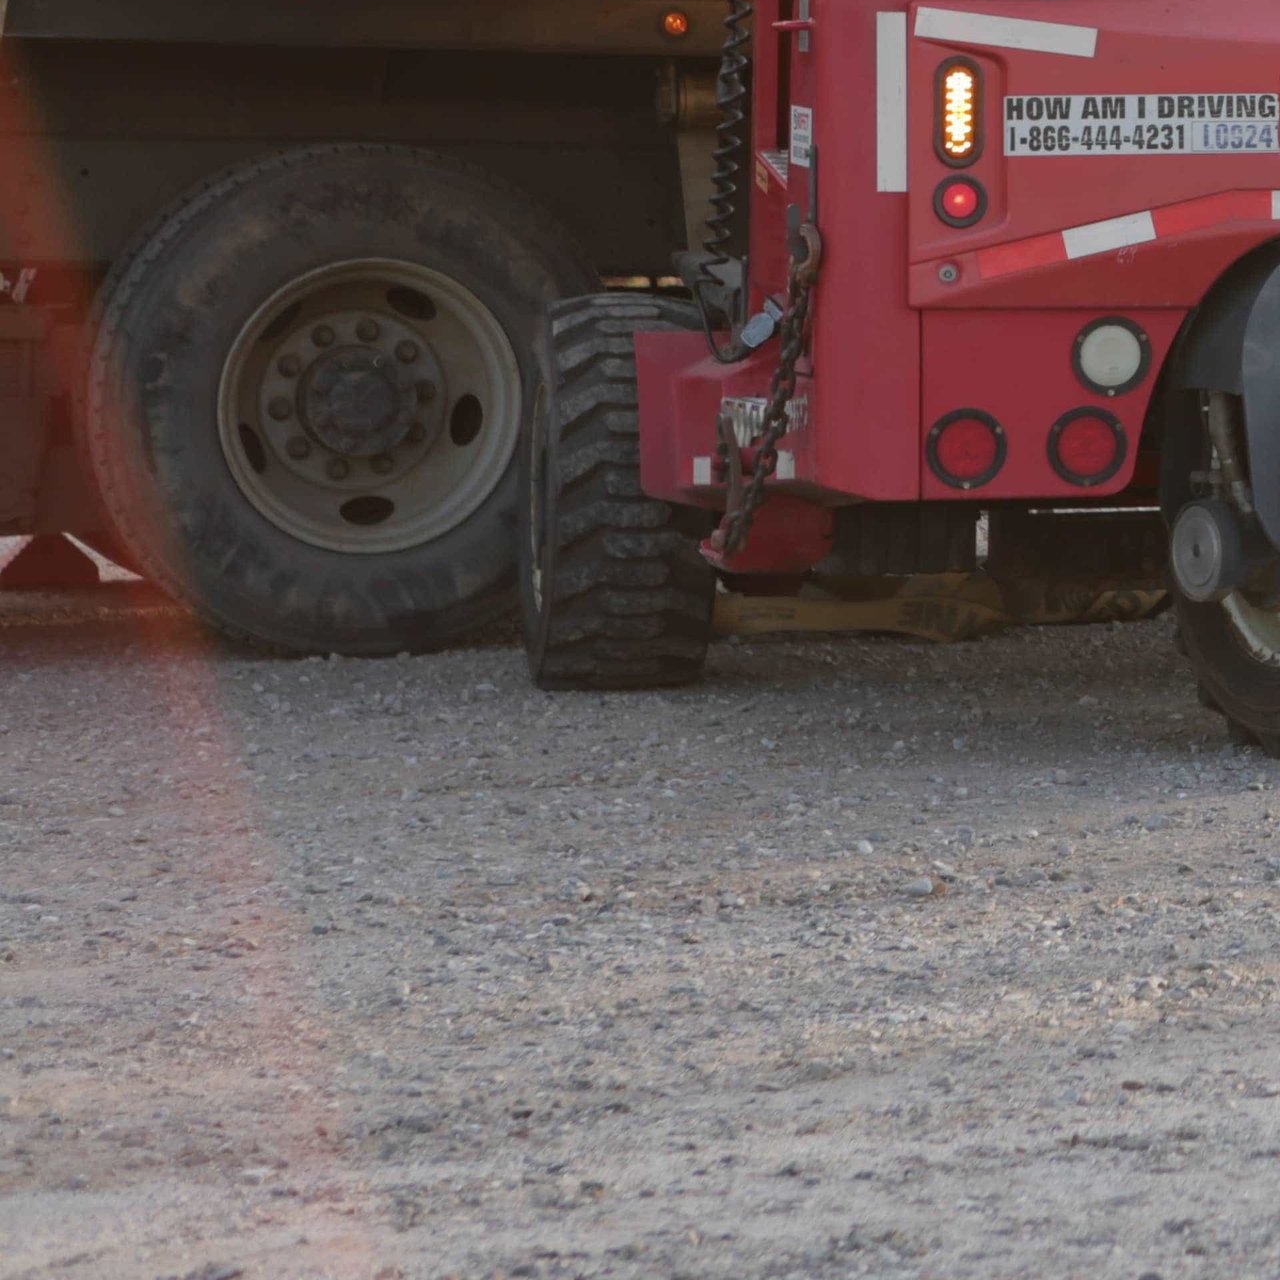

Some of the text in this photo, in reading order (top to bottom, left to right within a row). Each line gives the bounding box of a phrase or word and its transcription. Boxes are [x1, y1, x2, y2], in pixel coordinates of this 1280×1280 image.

[1006, 97, 1071, 120] HOW
[1081, 96, 1126, 119] AM
[1137, 96, 1146, 119] I
[1009, 124, 1185, 152] 1-866-444-4231
